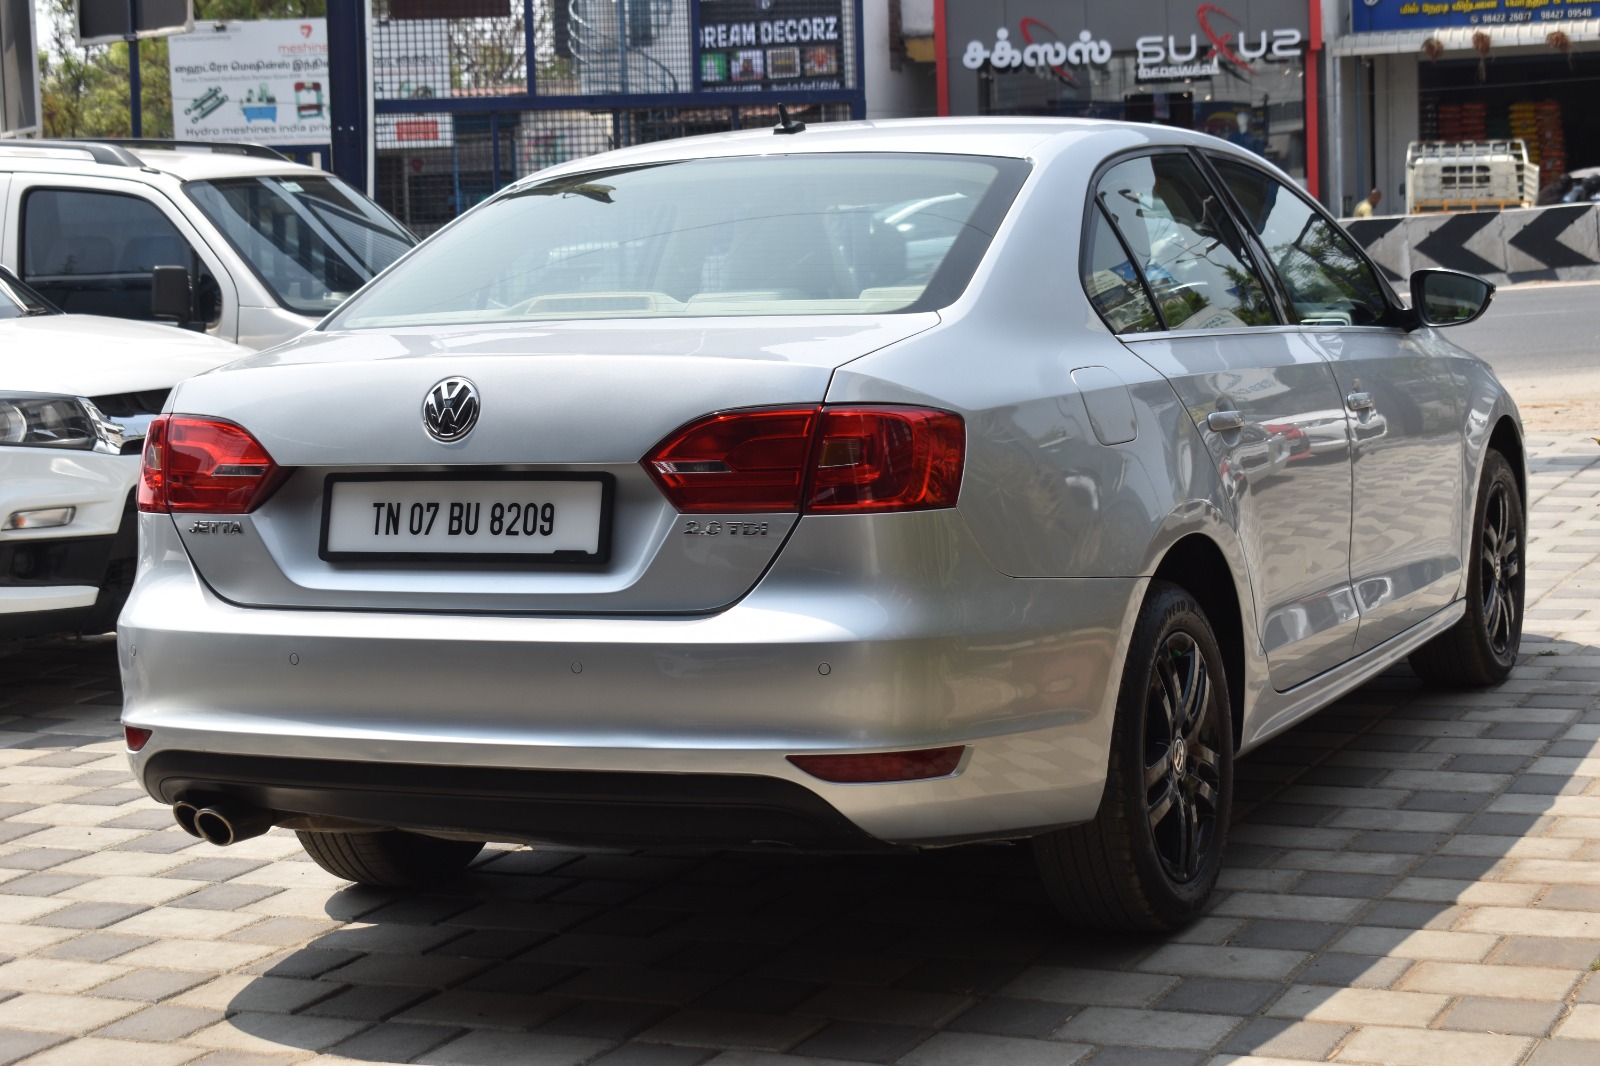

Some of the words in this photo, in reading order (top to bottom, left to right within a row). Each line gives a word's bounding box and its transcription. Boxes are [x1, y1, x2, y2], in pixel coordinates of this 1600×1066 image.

[760, 16, 838, 44] DECORZ
[186, 127, 220, 136] Hydro
[373, 502, 401, 535] TN
[409, 502, 440, 535] 07
[448, 502, 480, 535] BU
[490, 502, 555, 536] 8209
[189, 520, 243, 534] JETTA
[683, 520, 722, 535] 2.0
[726, 521, 768, 535] TDI
